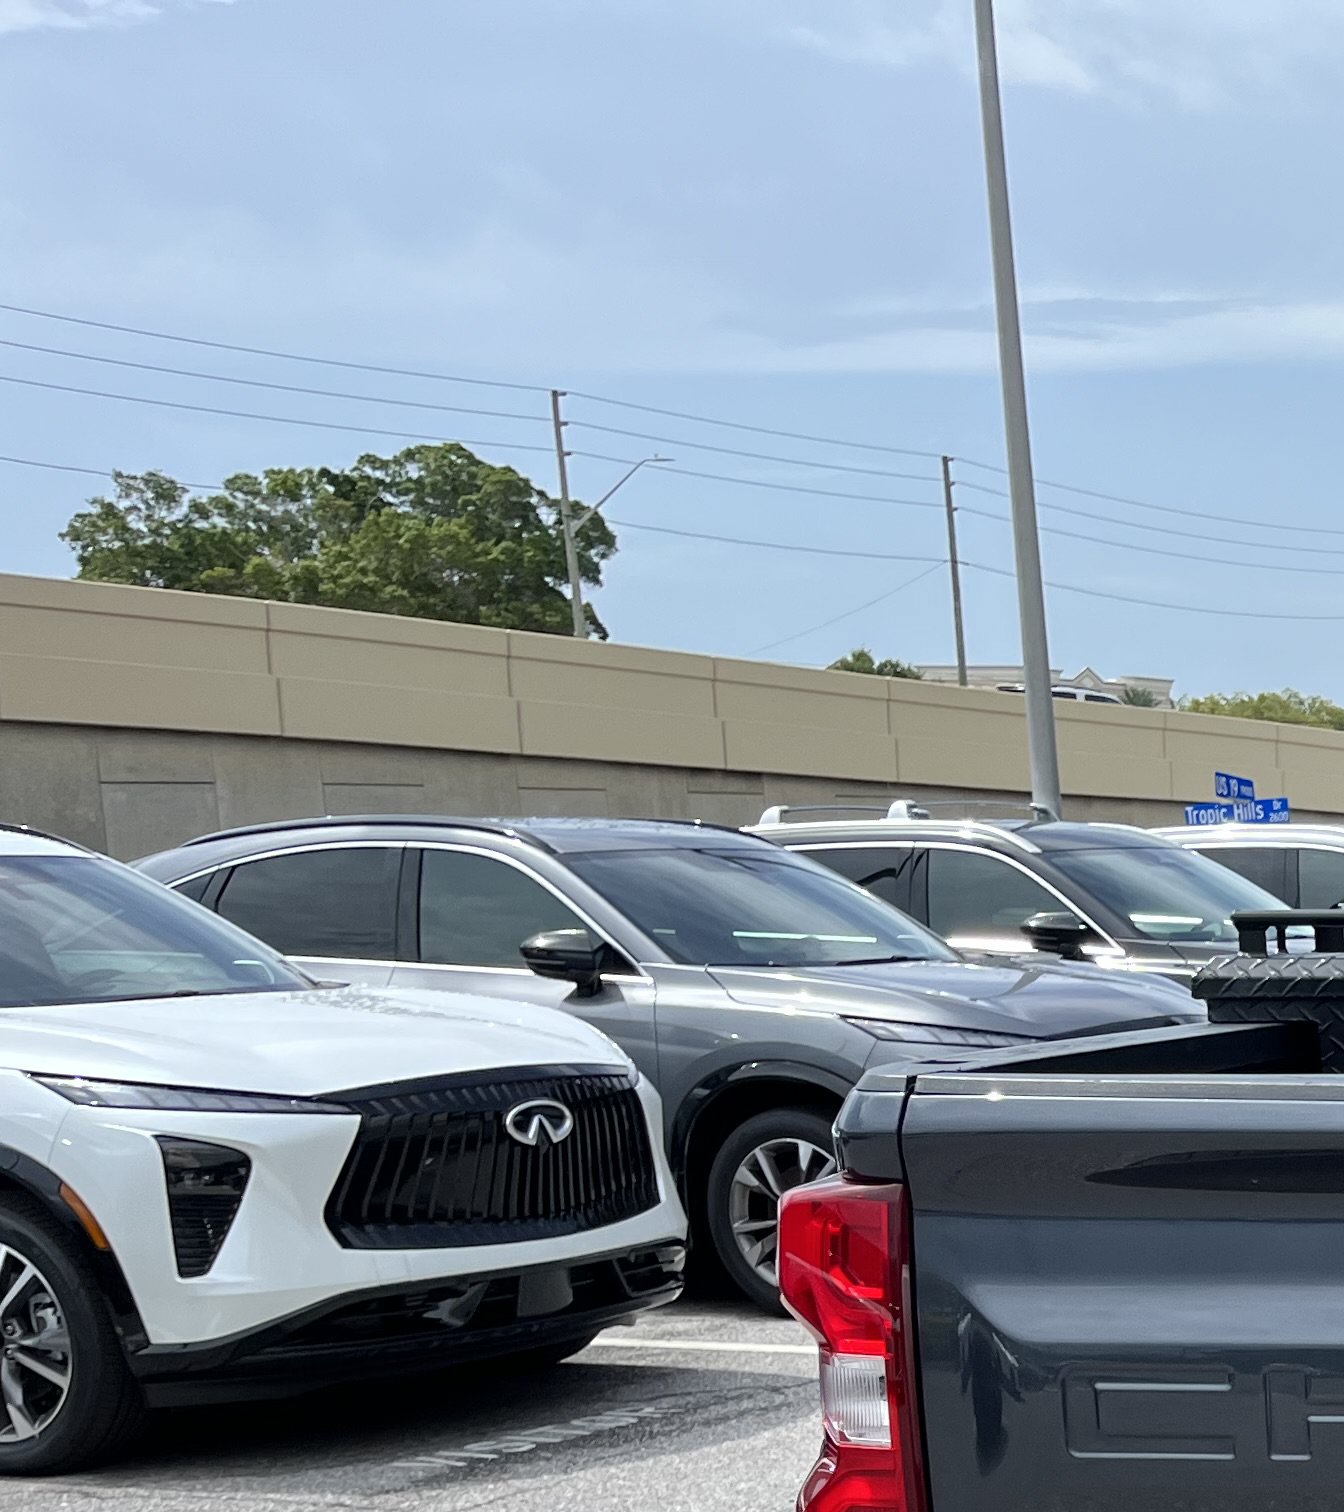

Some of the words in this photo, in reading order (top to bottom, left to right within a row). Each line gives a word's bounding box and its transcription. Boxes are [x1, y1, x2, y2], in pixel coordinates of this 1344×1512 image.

[1216, 776, 1228, 796] US
[1229, 778, 1239, 798] 19
[1185, 804, 1228, 824] Tropic
[1233, 801, 1265, 822] Hills
[1272, 800, 1283, 811] Dr
